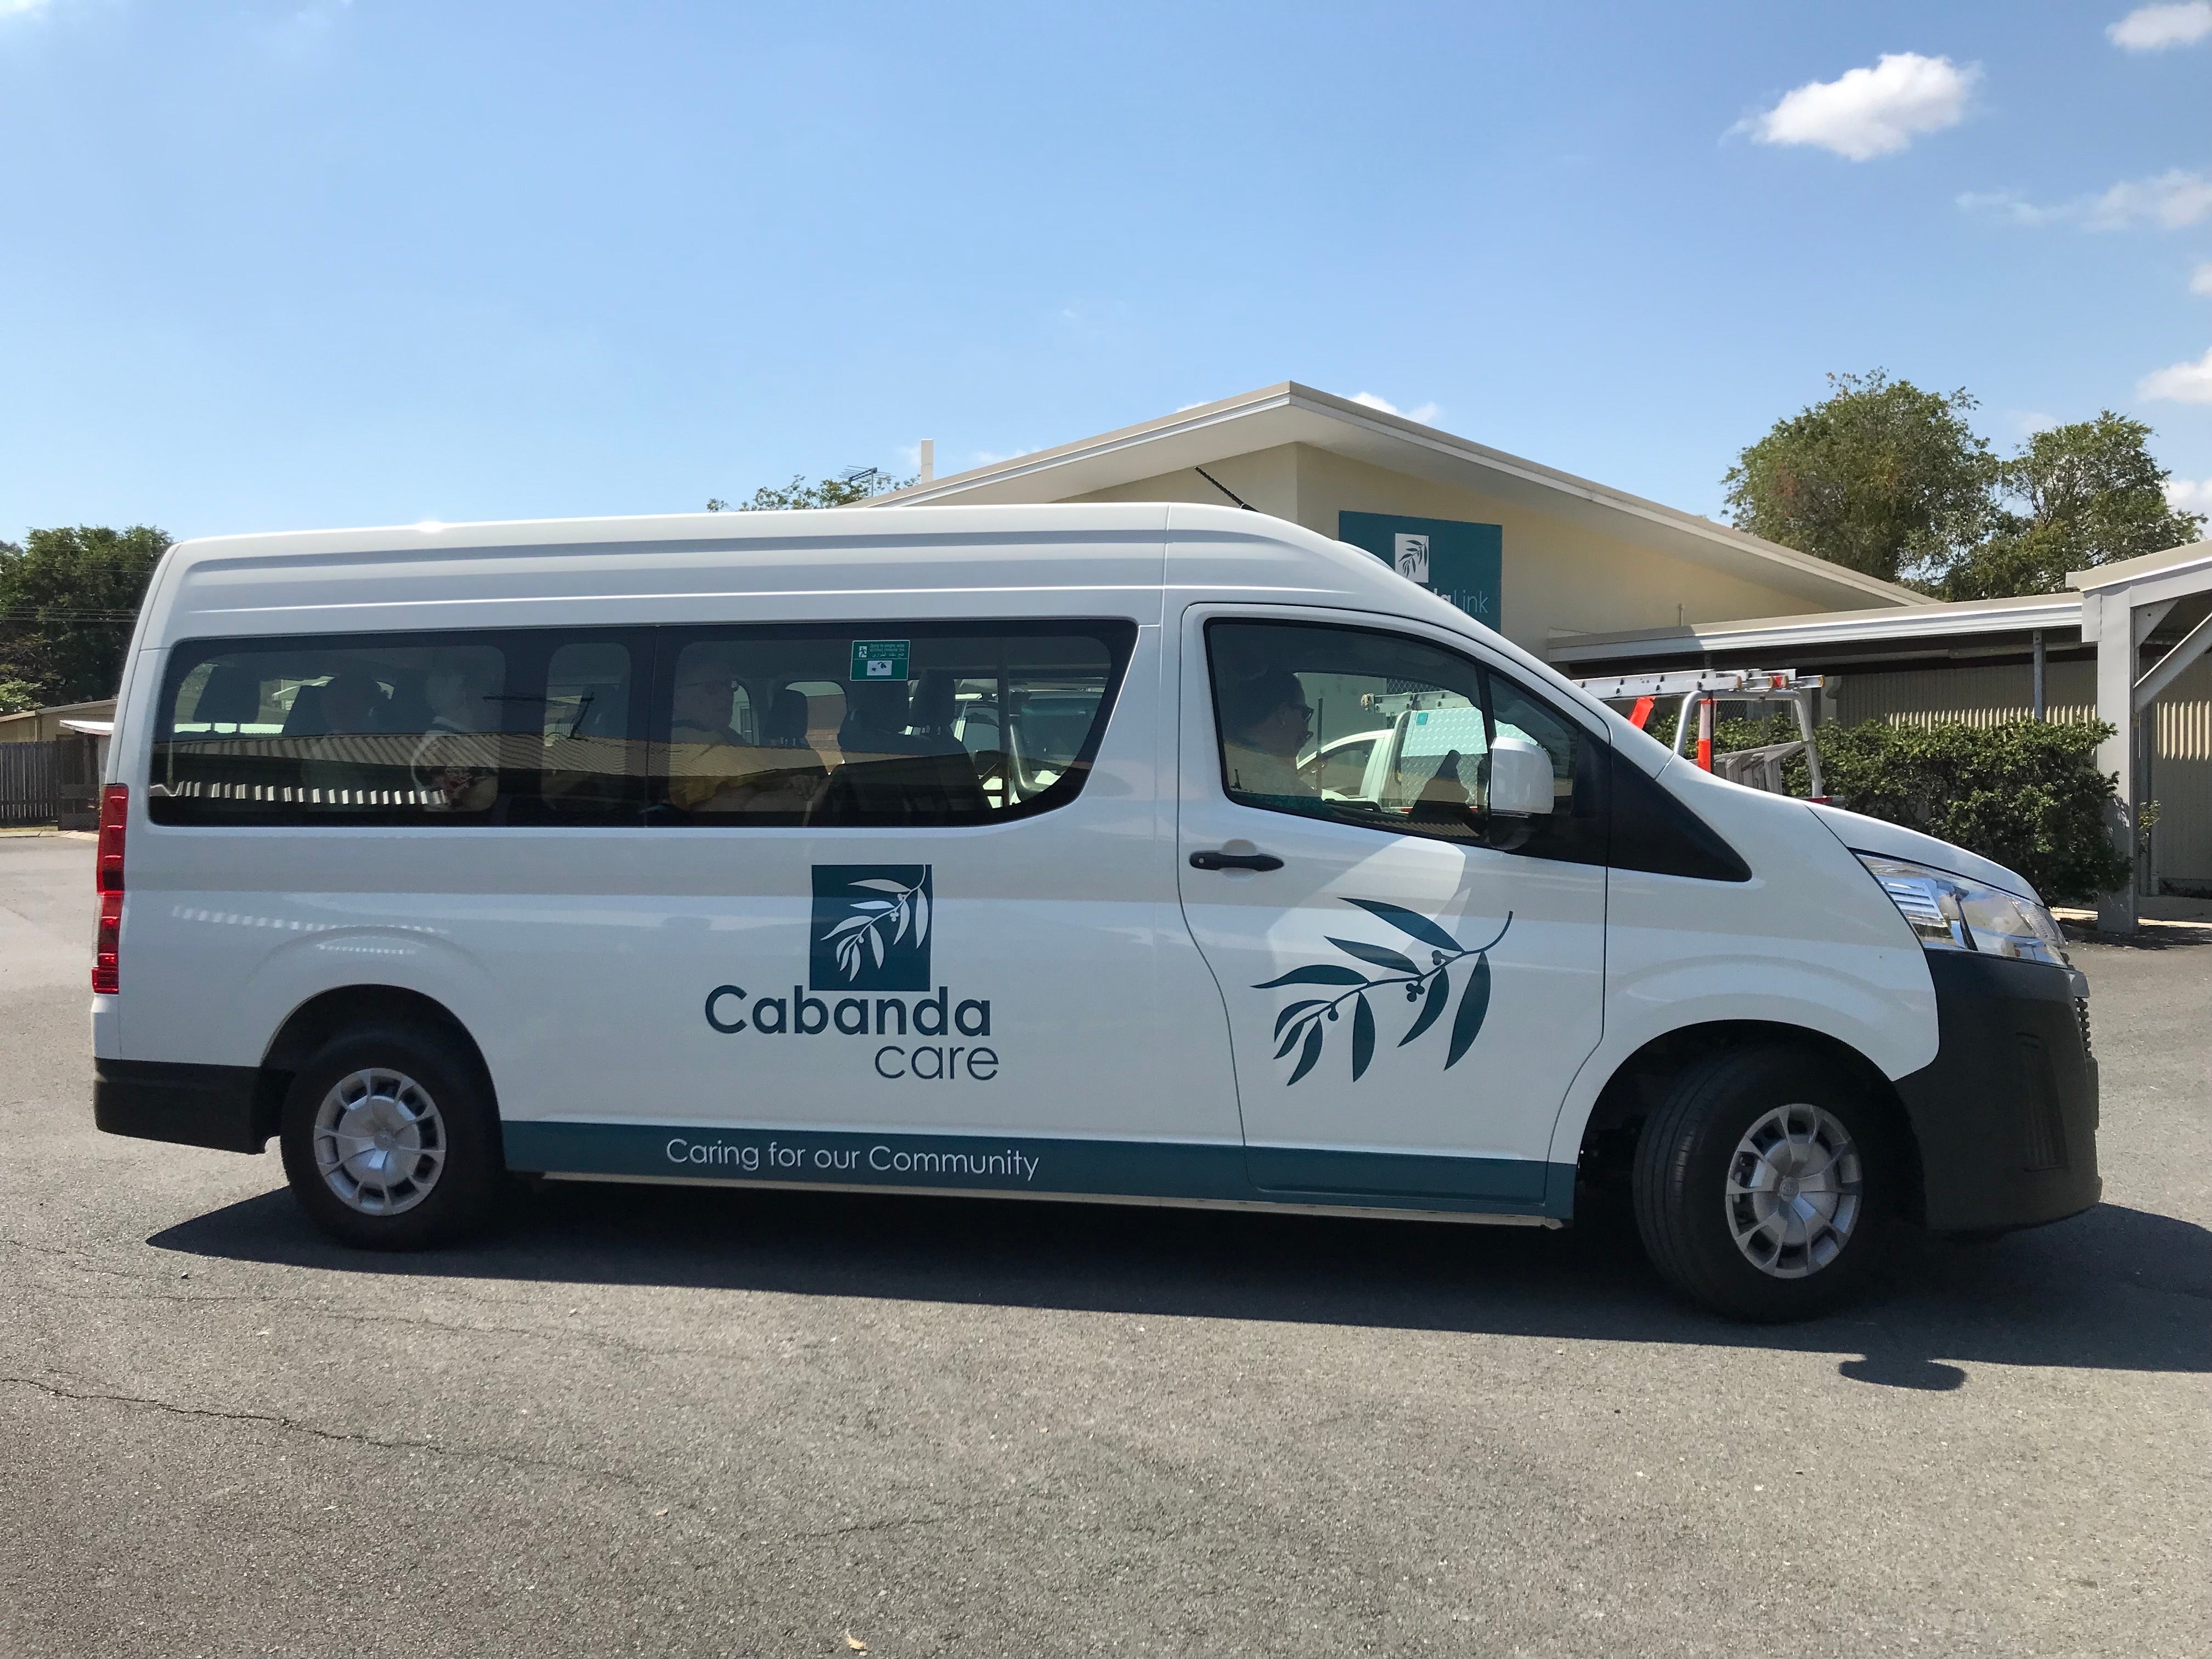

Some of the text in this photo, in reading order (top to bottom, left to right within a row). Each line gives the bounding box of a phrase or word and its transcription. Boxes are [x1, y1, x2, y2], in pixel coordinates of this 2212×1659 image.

[705, 985, 991, 1036] Cabanda
[875, 1046, 999, 1081] care
[666, 1138, 1040, 1181] Caring for our Community
